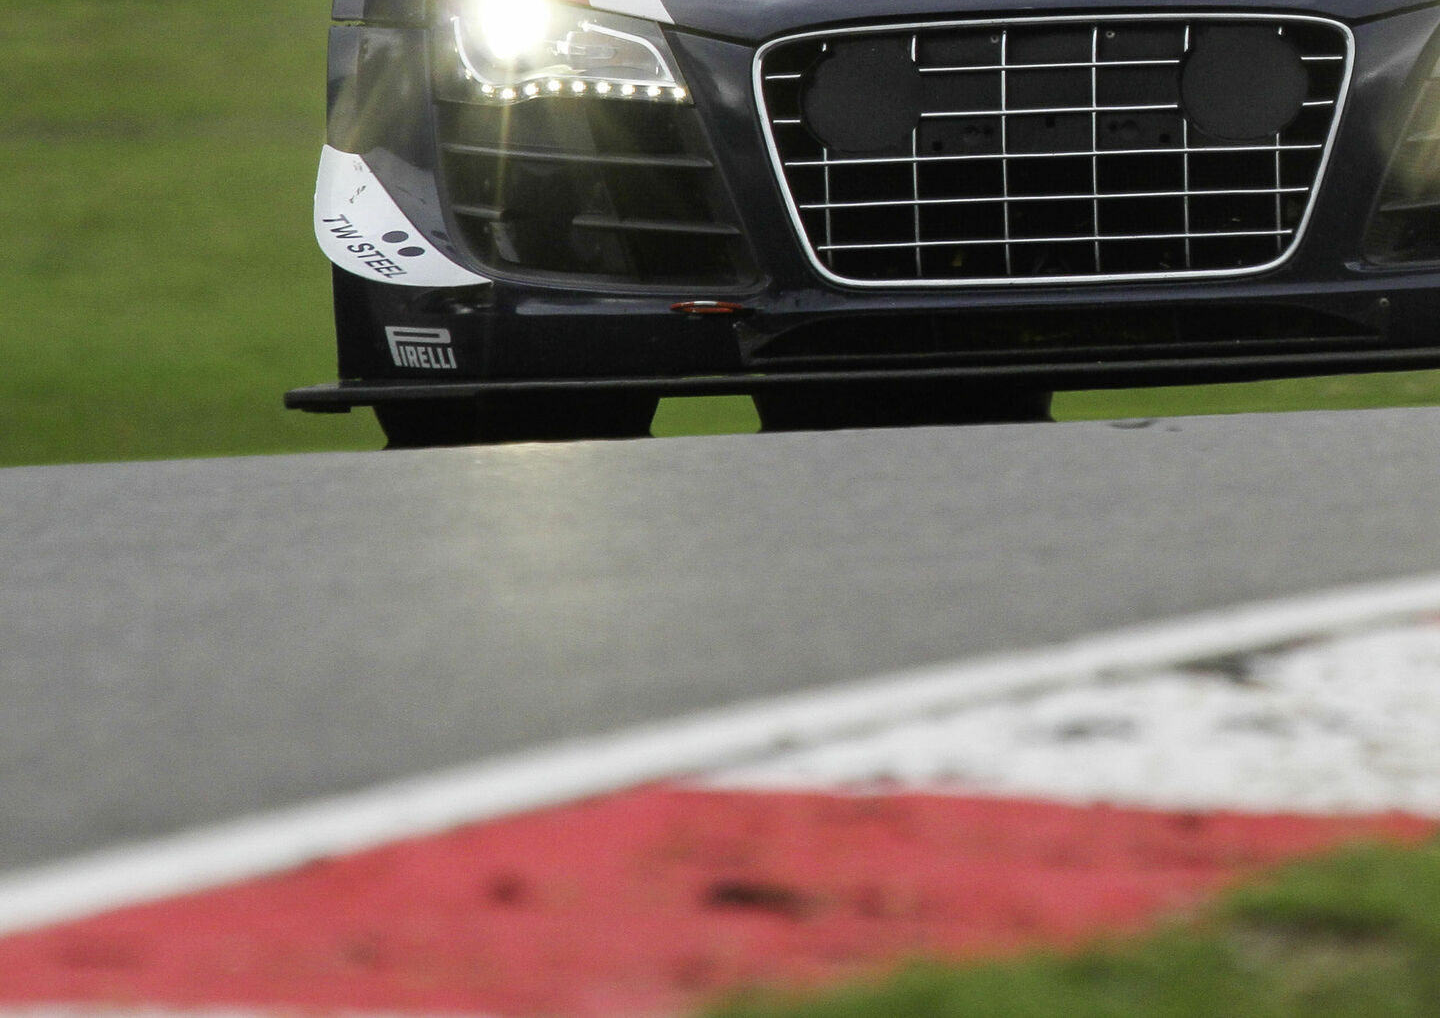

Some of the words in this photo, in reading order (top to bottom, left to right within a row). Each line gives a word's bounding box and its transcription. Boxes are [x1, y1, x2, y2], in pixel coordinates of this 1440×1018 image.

[322, 213, 362, 240] TW
[347, 242, 408, 278] STEEL
[384, 325, 457, 369] PIRELLI
